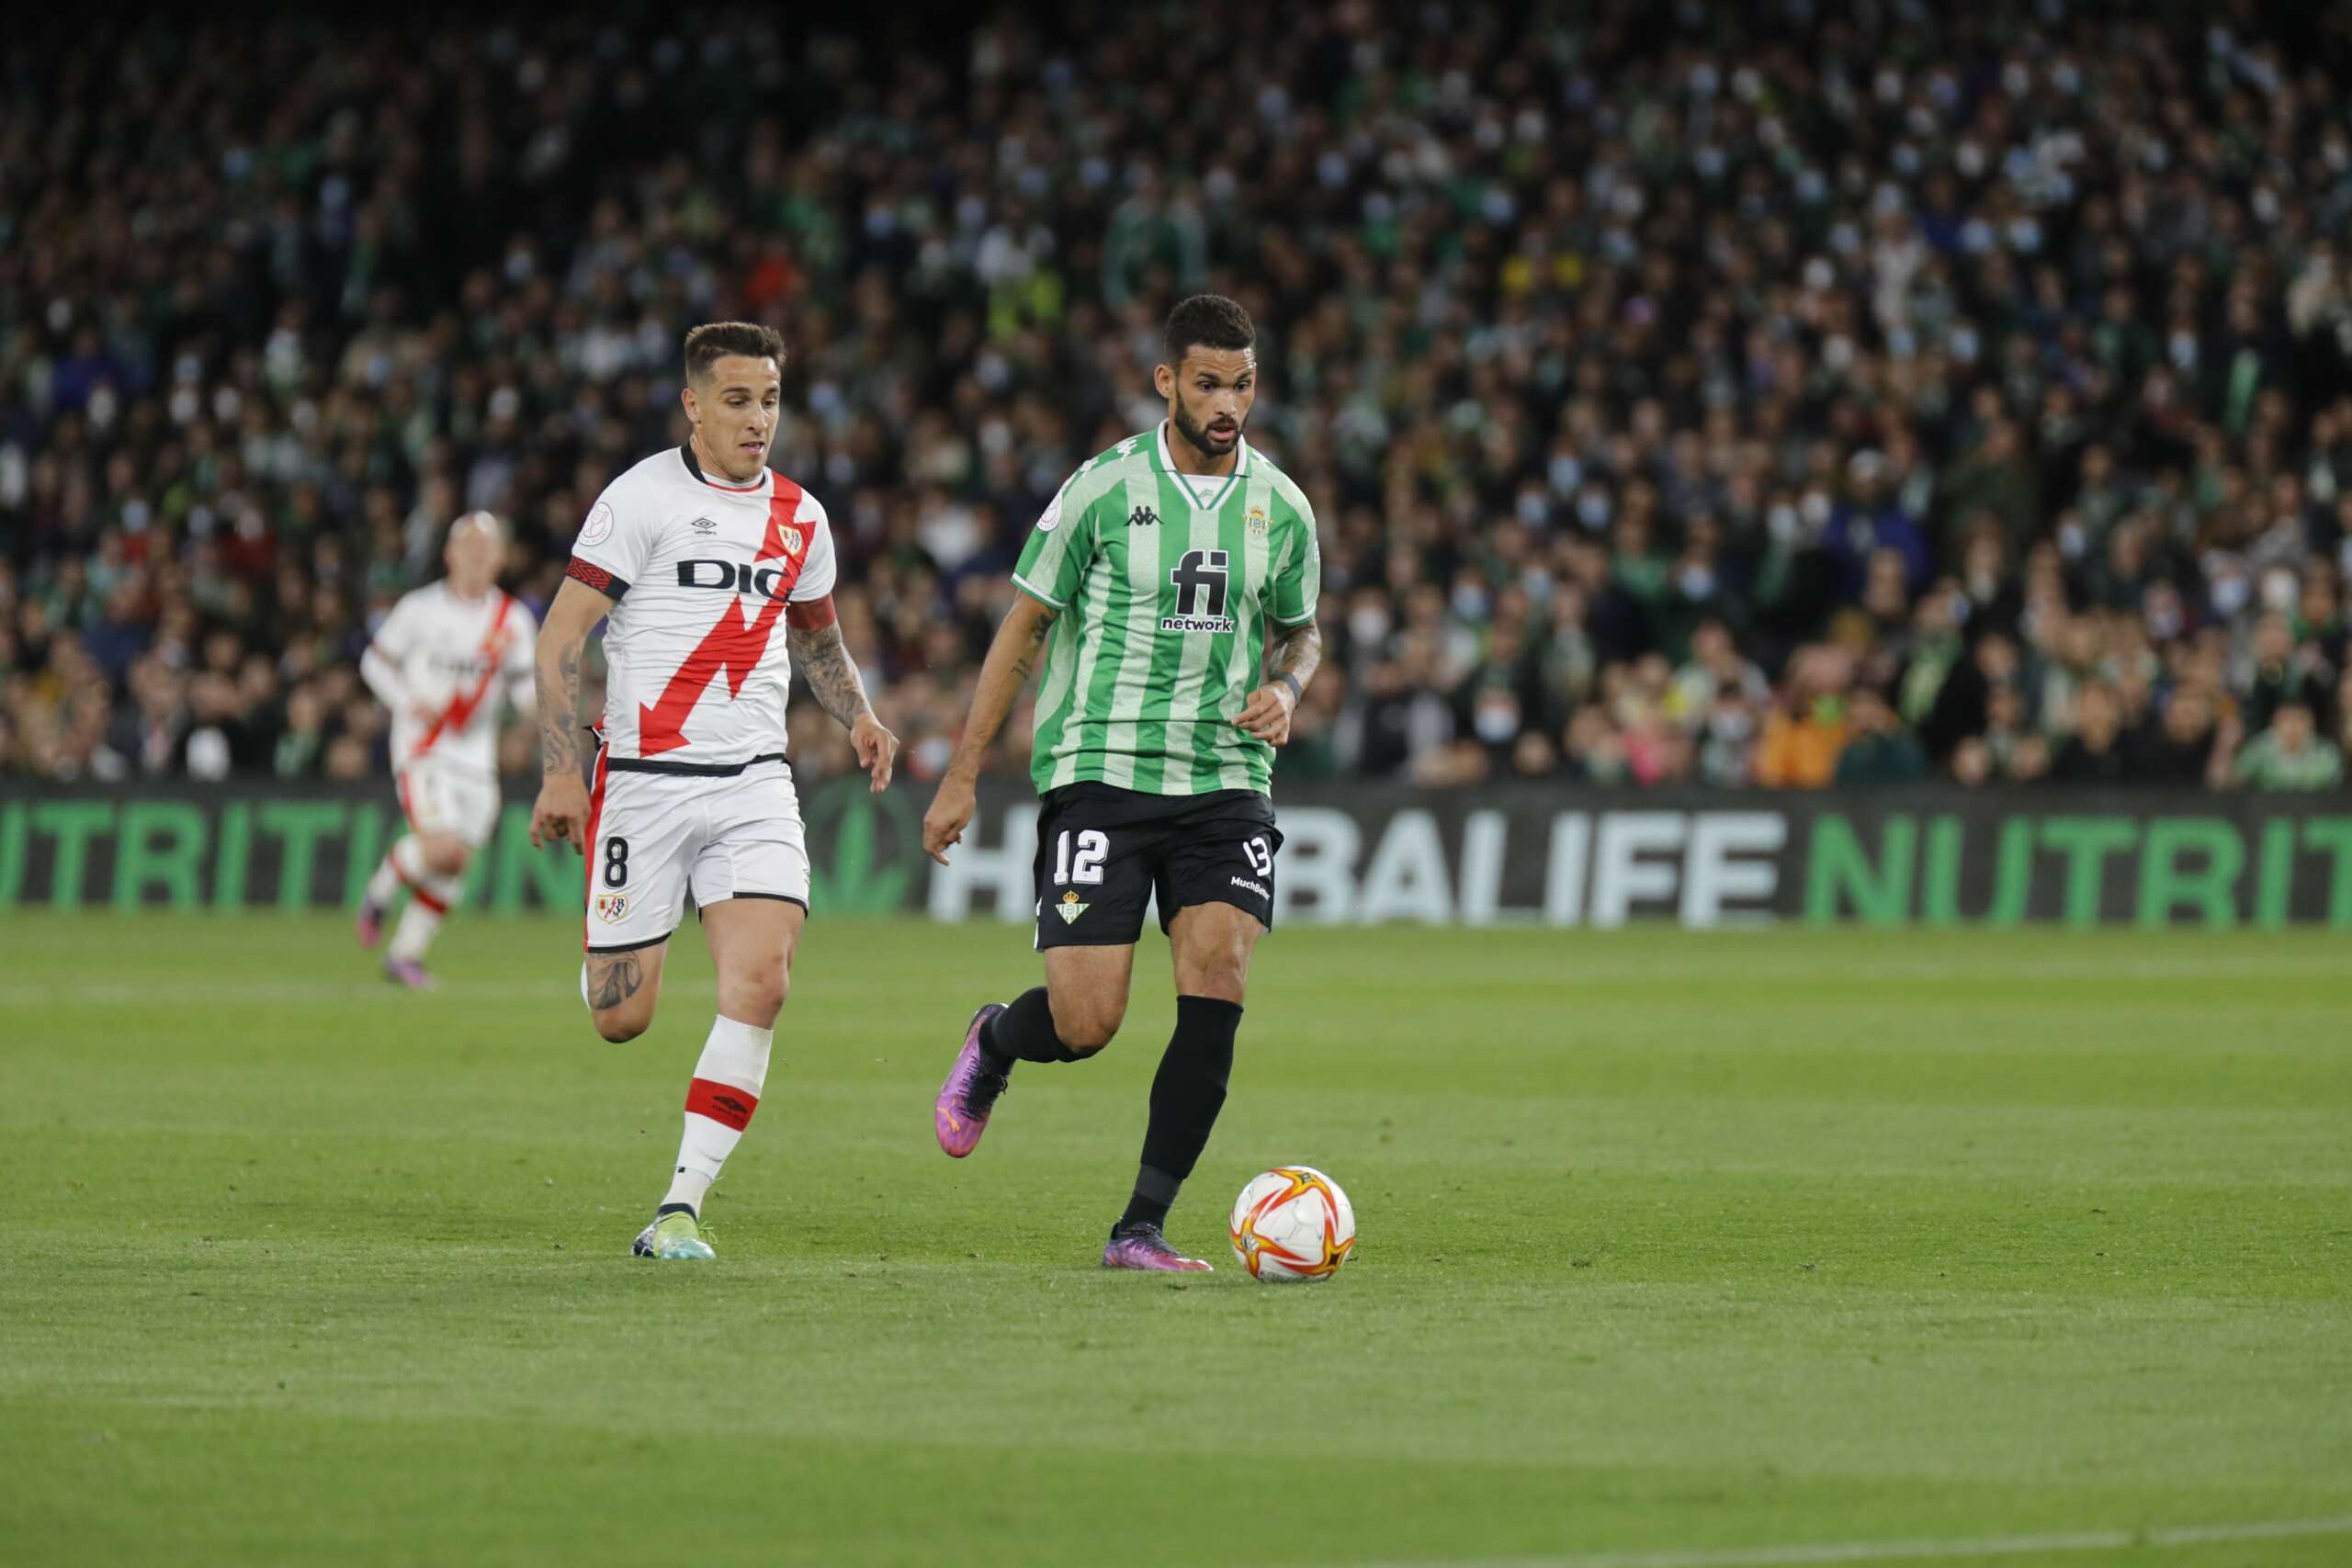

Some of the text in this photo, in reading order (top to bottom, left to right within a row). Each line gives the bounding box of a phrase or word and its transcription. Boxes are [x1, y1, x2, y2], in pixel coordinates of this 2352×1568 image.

[1171, 551, 1227, 616] fi
[1162, 616, 1234, 632] network
[0, 800, 586, 912] TRITIN
[603, 836, 628, 889] 8
[927, 807, 1788, 925] HBALIFE
[1054, 829, 1109, 886] 12
